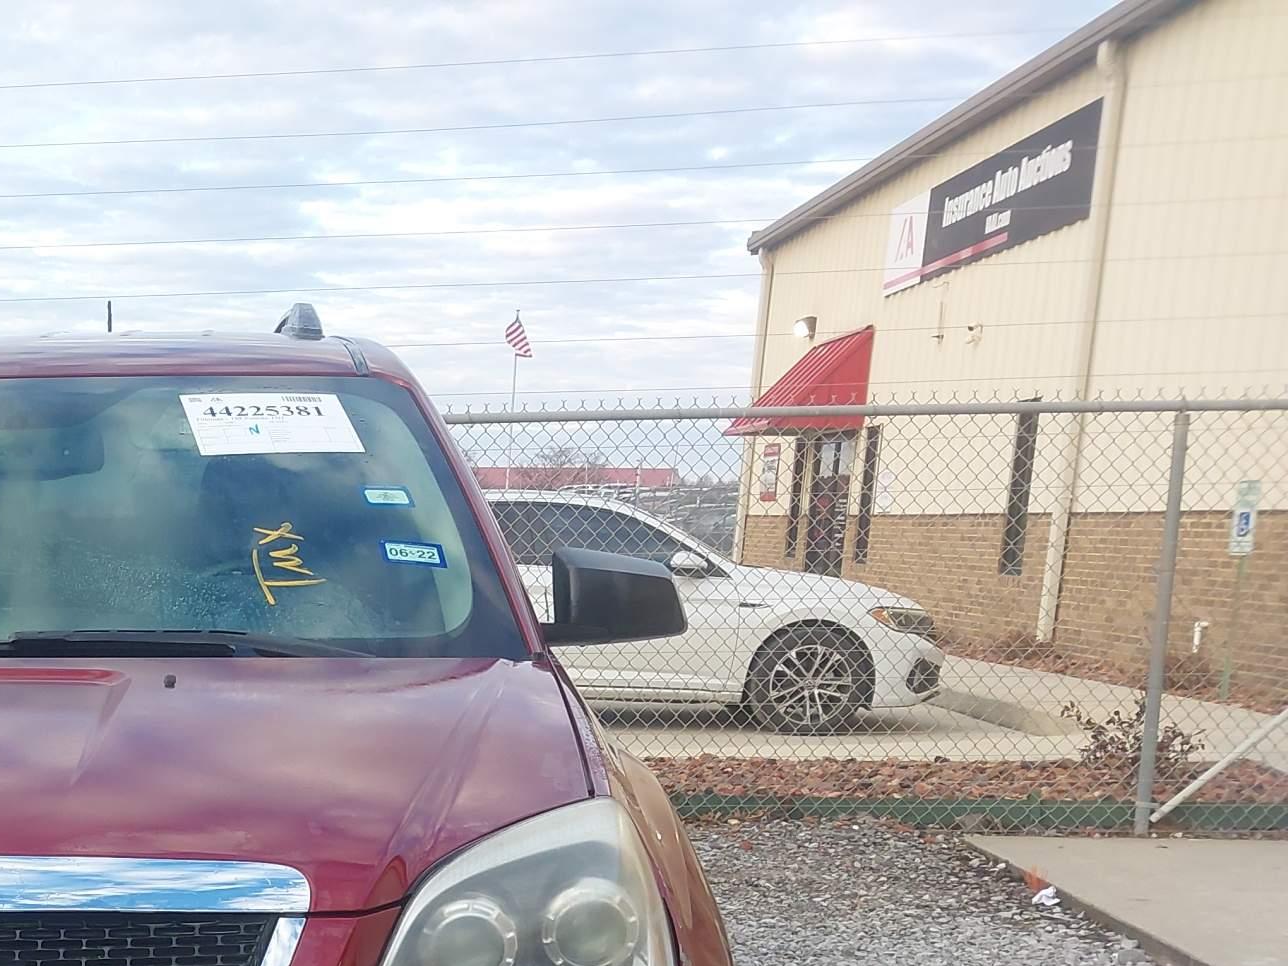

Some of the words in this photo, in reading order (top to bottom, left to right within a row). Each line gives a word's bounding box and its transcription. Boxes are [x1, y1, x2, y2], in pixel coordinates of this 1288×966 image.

[942, 178, 993, 228] Insurance
[991, 165, 1019, 204] Auto
[1017, 139, 1073, 193] Auctions
[203, 405, 326, 417] 44225381
[388, 546, 437, 561] 06-22
